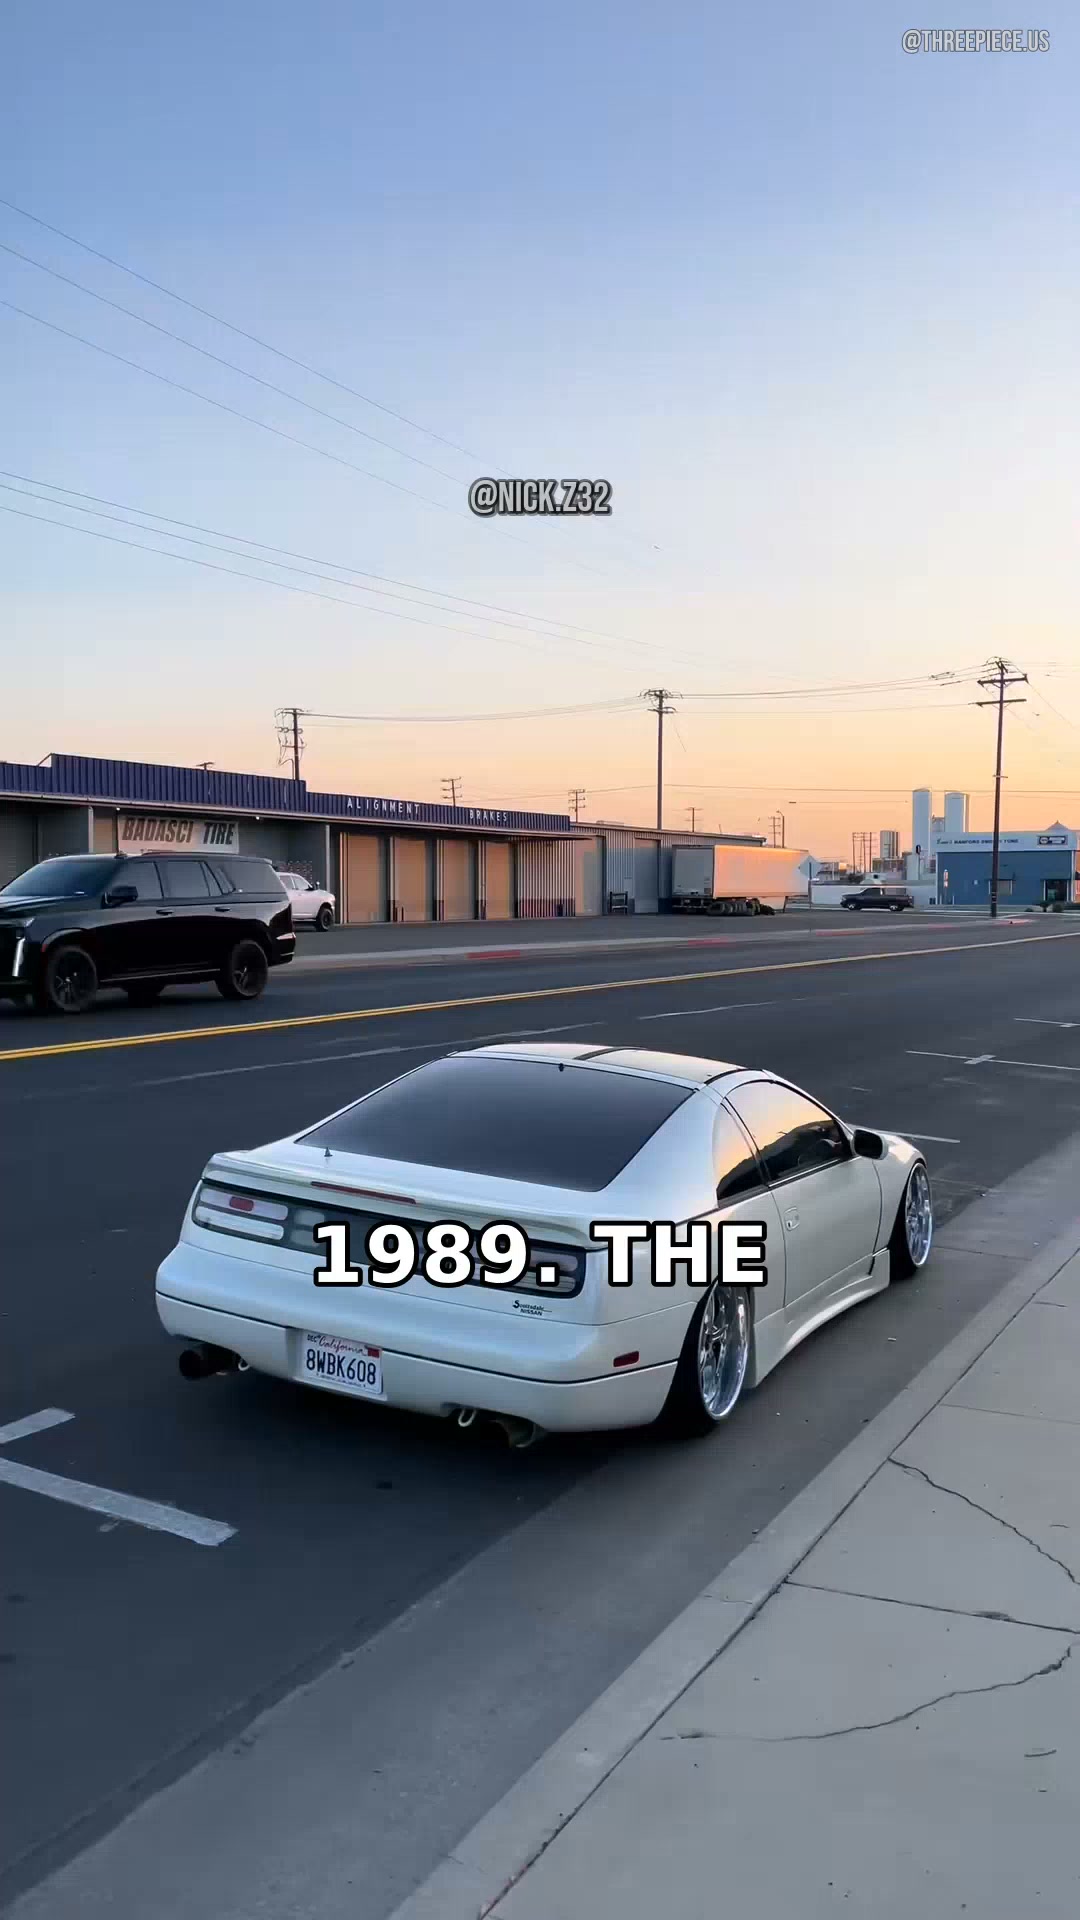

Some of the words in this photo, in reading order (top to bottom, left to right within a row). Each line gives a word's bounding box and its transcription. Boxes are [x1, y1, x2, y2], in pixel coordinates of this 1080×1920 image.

[347, 798, 420, 814] ALIGNMENT
[470, 809, 507, 822] BRAKES
[122, 817, 194, 843] BADASCI
[203, 821, 235, 845] TIRE
[520, 1308, 543, 1316] NISSAN
[319, 1335, 363, 1353] California
[306, 1348, 377, 1385] 8WBK608
